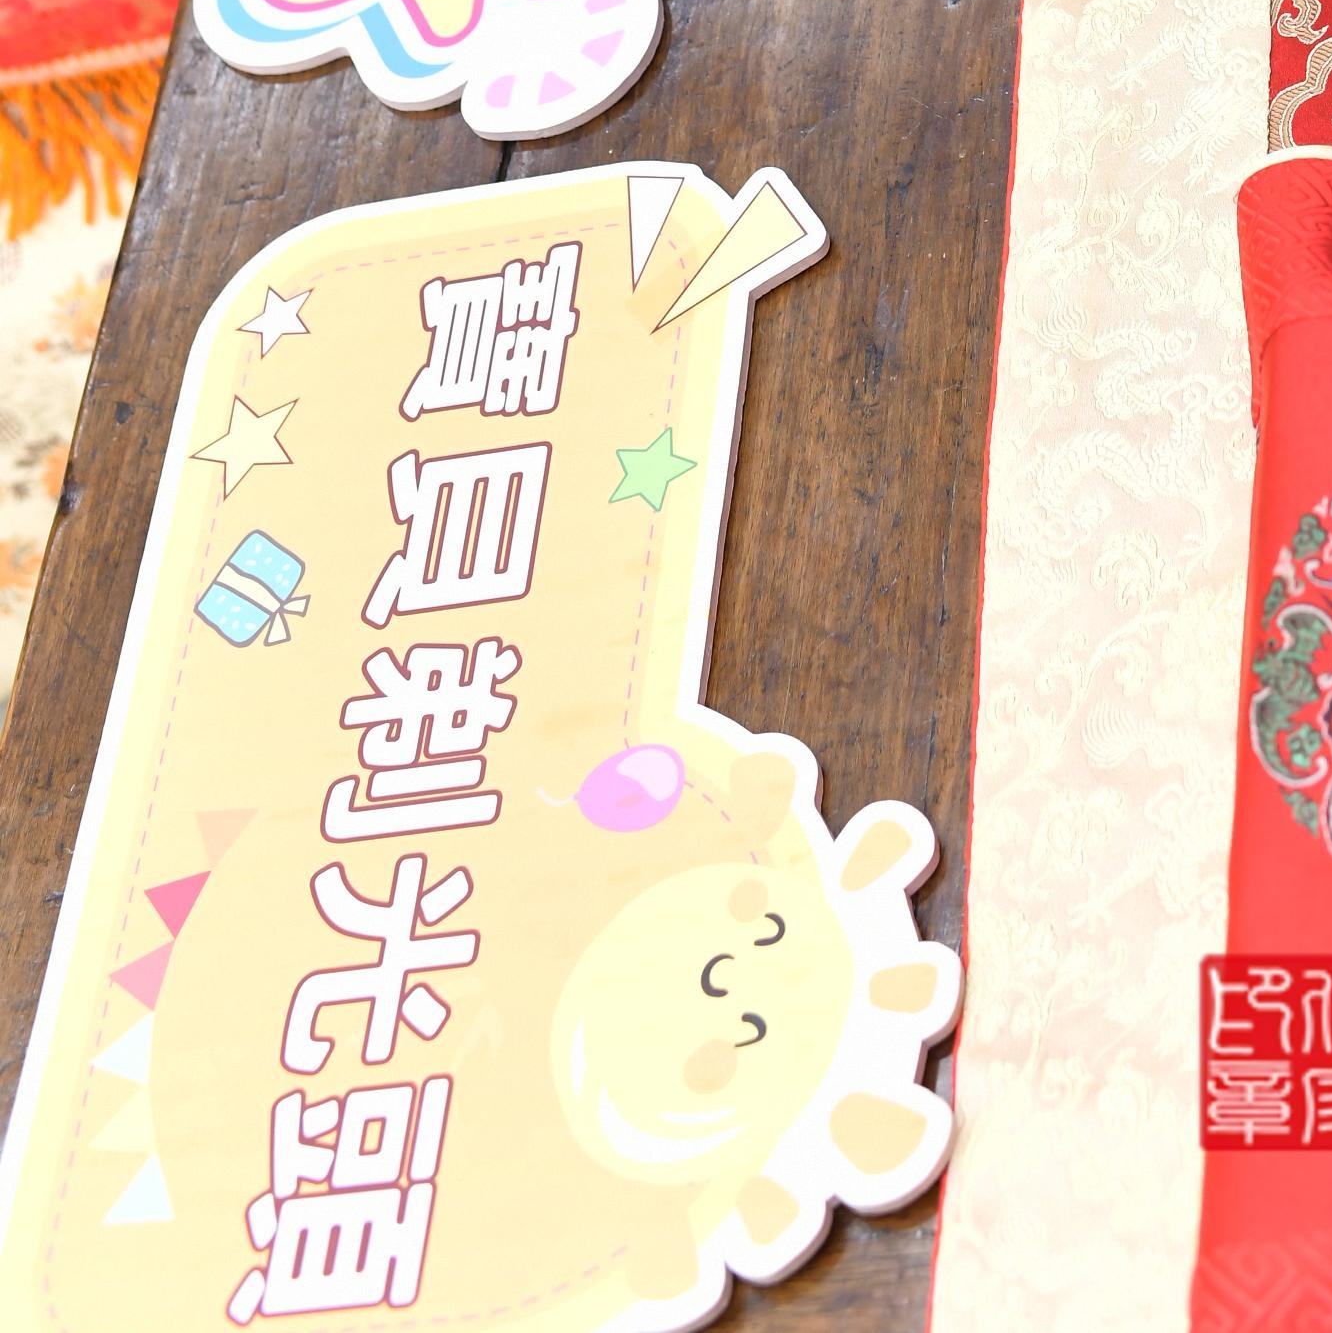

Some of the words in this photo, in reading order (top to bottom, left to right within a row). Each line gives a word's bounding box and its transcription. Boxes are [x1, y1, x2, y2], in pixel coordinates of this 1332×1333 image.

[226, 240, 584, 1327] 寶貝剃光頭
